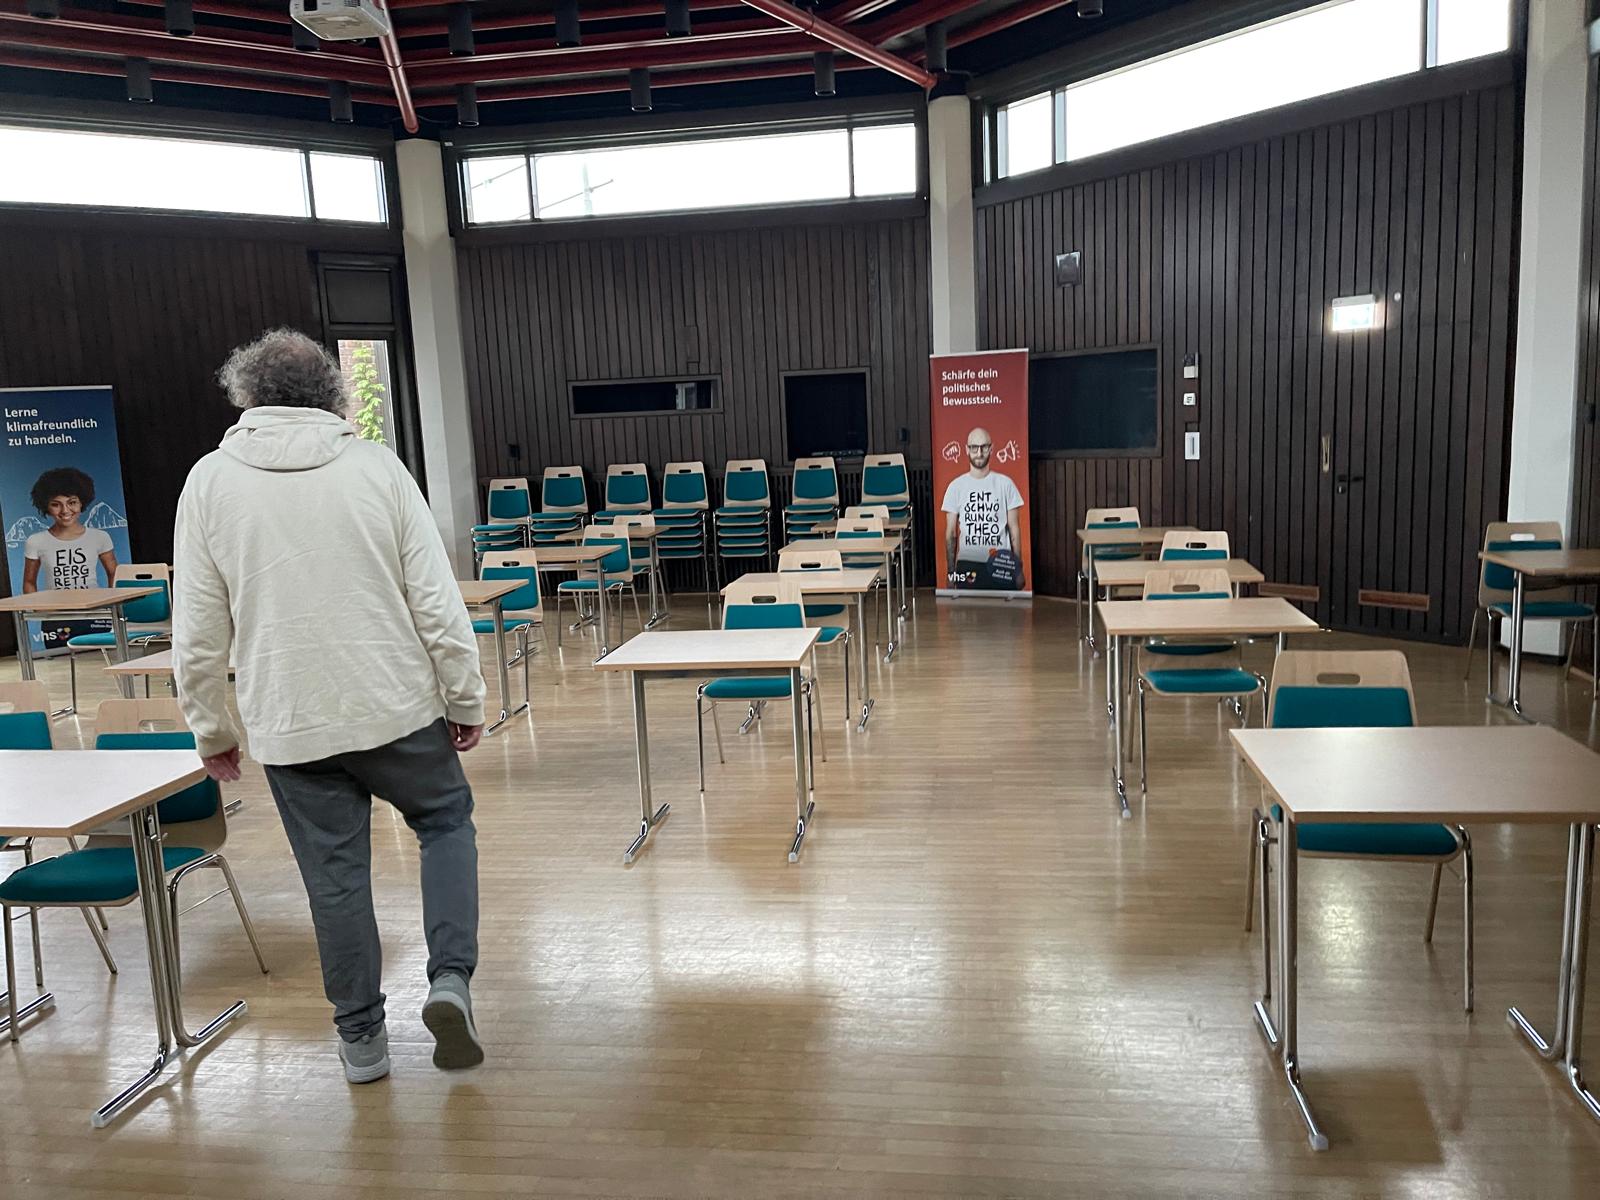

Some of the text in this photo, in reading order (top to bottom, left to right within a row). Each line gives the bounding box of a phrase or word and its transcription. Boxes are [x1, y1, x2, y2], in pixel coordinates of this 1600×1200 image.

[942, 368, 998, 381] Schärfe dein
[942, 382, 991, 396] politisches
[943, 394, 1002, 406] Bewusstsein.
[4, 407, 38, 418] Lerne
[6, 418, 98, 433] klimafreundlich
[8, 433, 77, 446] zu handeln.
[969, 491, 992, 503] ENT
[964, 512, 999, 523] RUNGS
[966, 522, 1000, 536] THEO
[965, 533, 1003, 546] RETIKER
[55, 547, 87, 567] EIS
[53, 565, 90, 577] BERG
[947, 571, 967, 582] vhs
[54, 575, 89, 587] RETT
[32, 630, 58, 643] vhs
